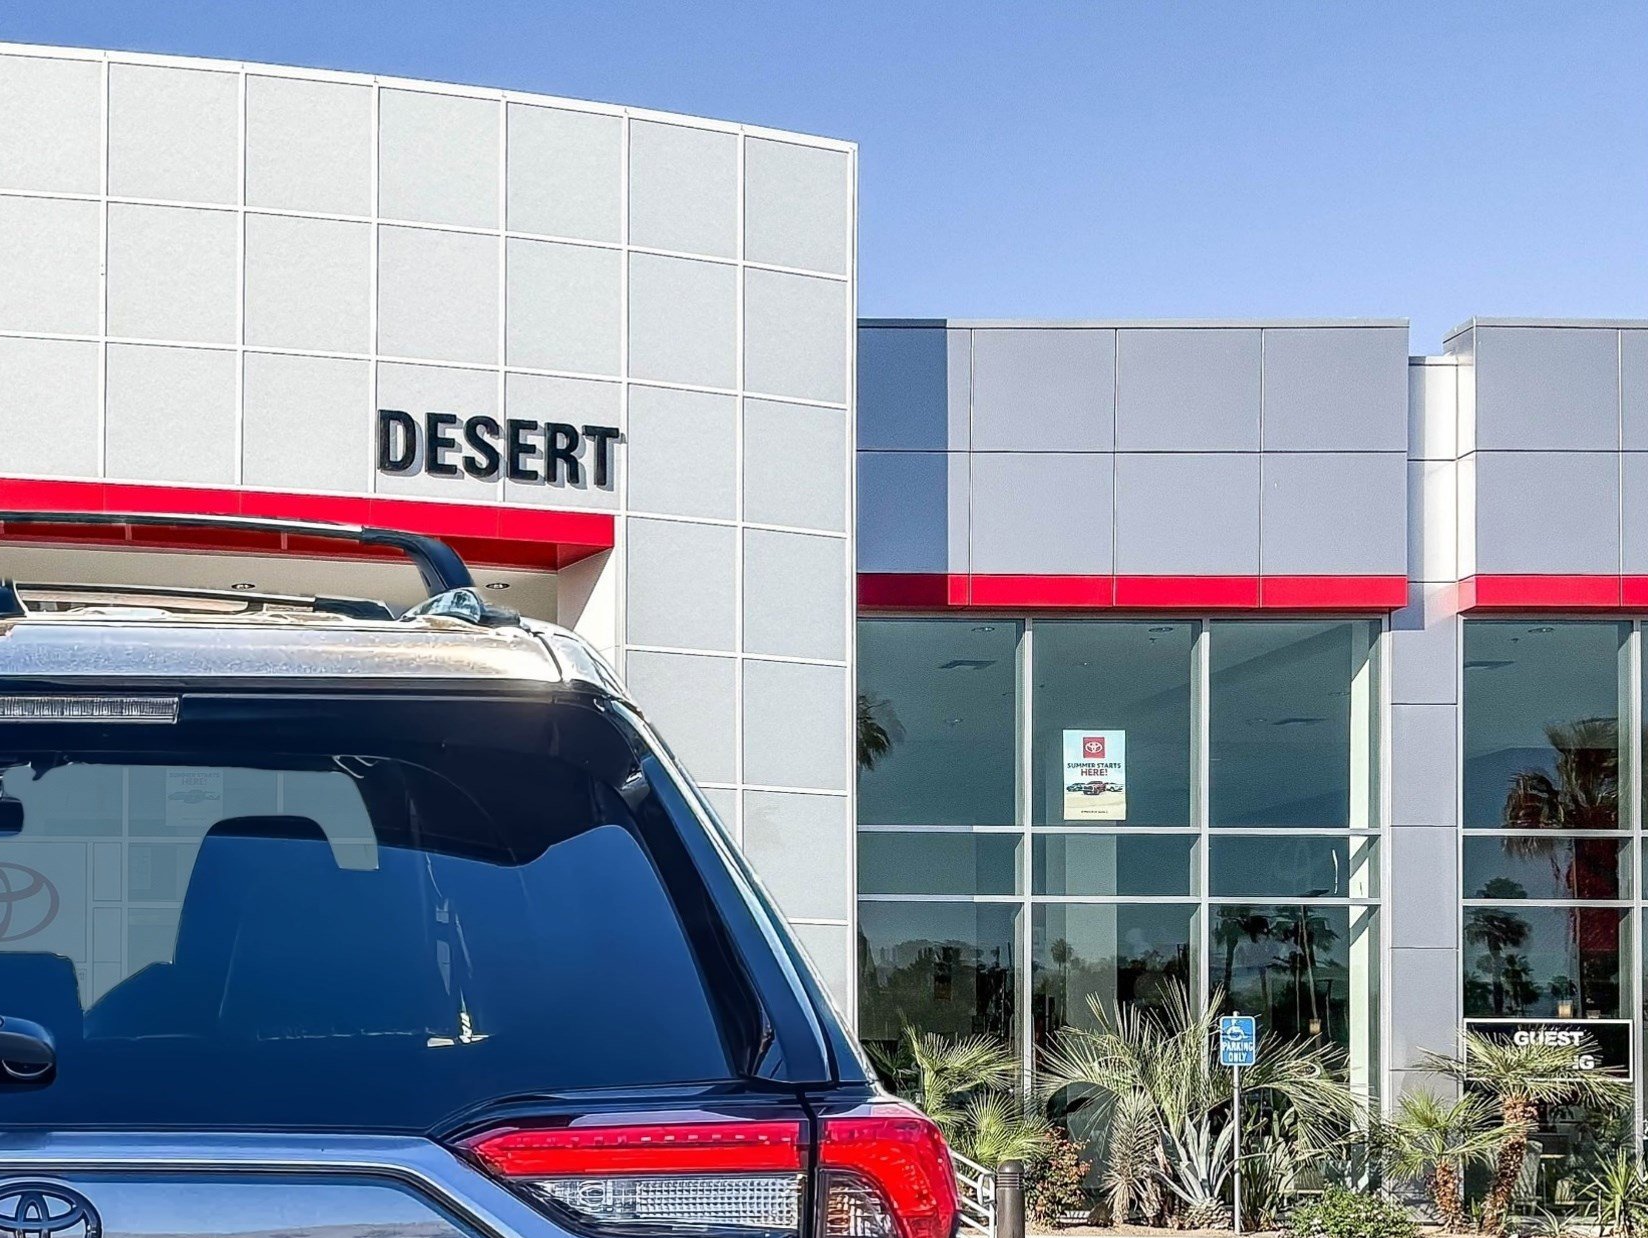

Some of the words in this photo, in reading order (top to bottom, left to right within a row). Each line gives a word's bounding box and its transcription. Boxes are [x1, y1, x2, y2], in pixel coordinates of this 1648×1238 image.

[377, 408, 620, 487] DESERT
[1080, 768, 1108, 776] HERE!
[1513, 1031, 1584, 1046] GUEST
[1222, 1041, 1253, 1052] PARKING
[1228, 1051, 1248, 1063] ONLY
